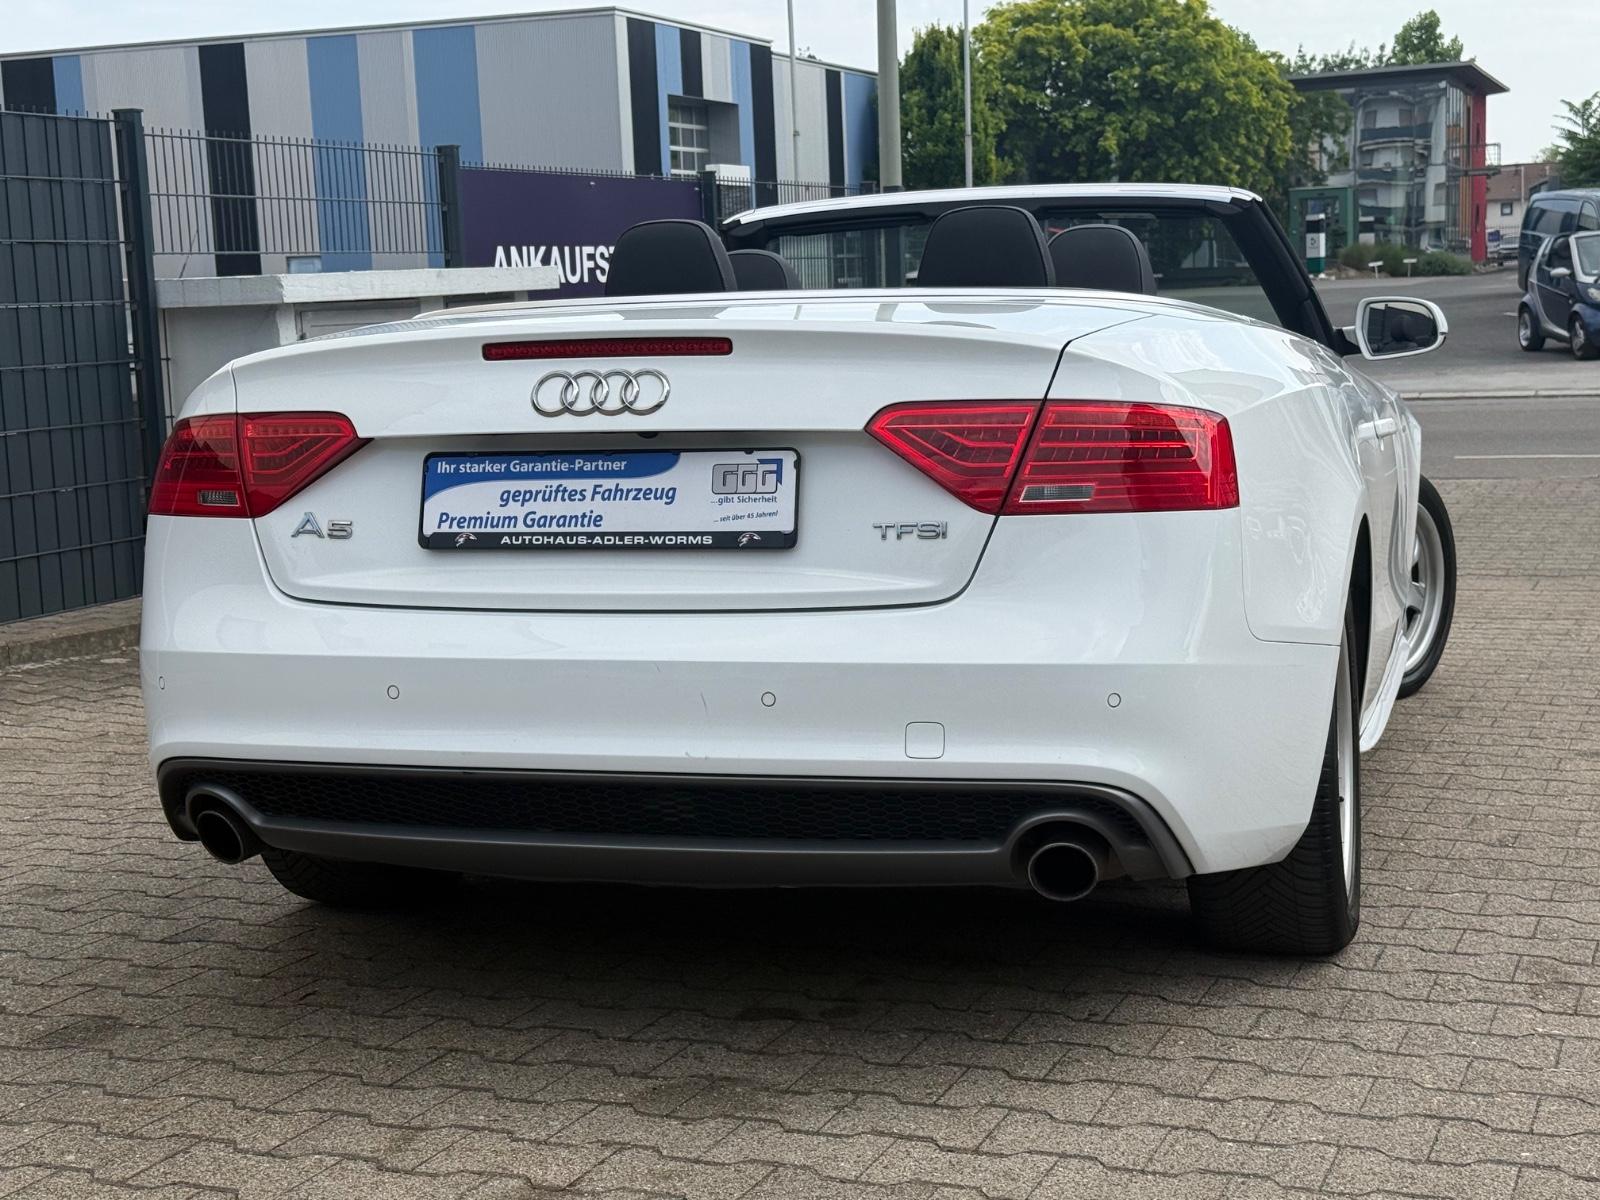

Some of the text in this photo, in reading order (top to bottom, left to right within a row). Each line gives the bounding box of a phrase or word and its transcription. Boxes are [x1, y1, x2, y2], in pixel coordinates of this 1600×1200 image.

[494, 245, 616, 284] ANKAUFS
[437, 458, 628, 474] Ihr starker Garantie-Partner
[499, 482, 677, 508] geprüftes Fahrzeug
[736, 495, 778, 504] Sicherheit
[290, 511, 353, 540] A5
[437, 509, 604, 530] Premium Garantie
[731, 513, 746, 521] über
[500, 535, 713, 545] AUTOHAUS-ADLER-WORMS
[872, 521, 948, 541] TFSI
